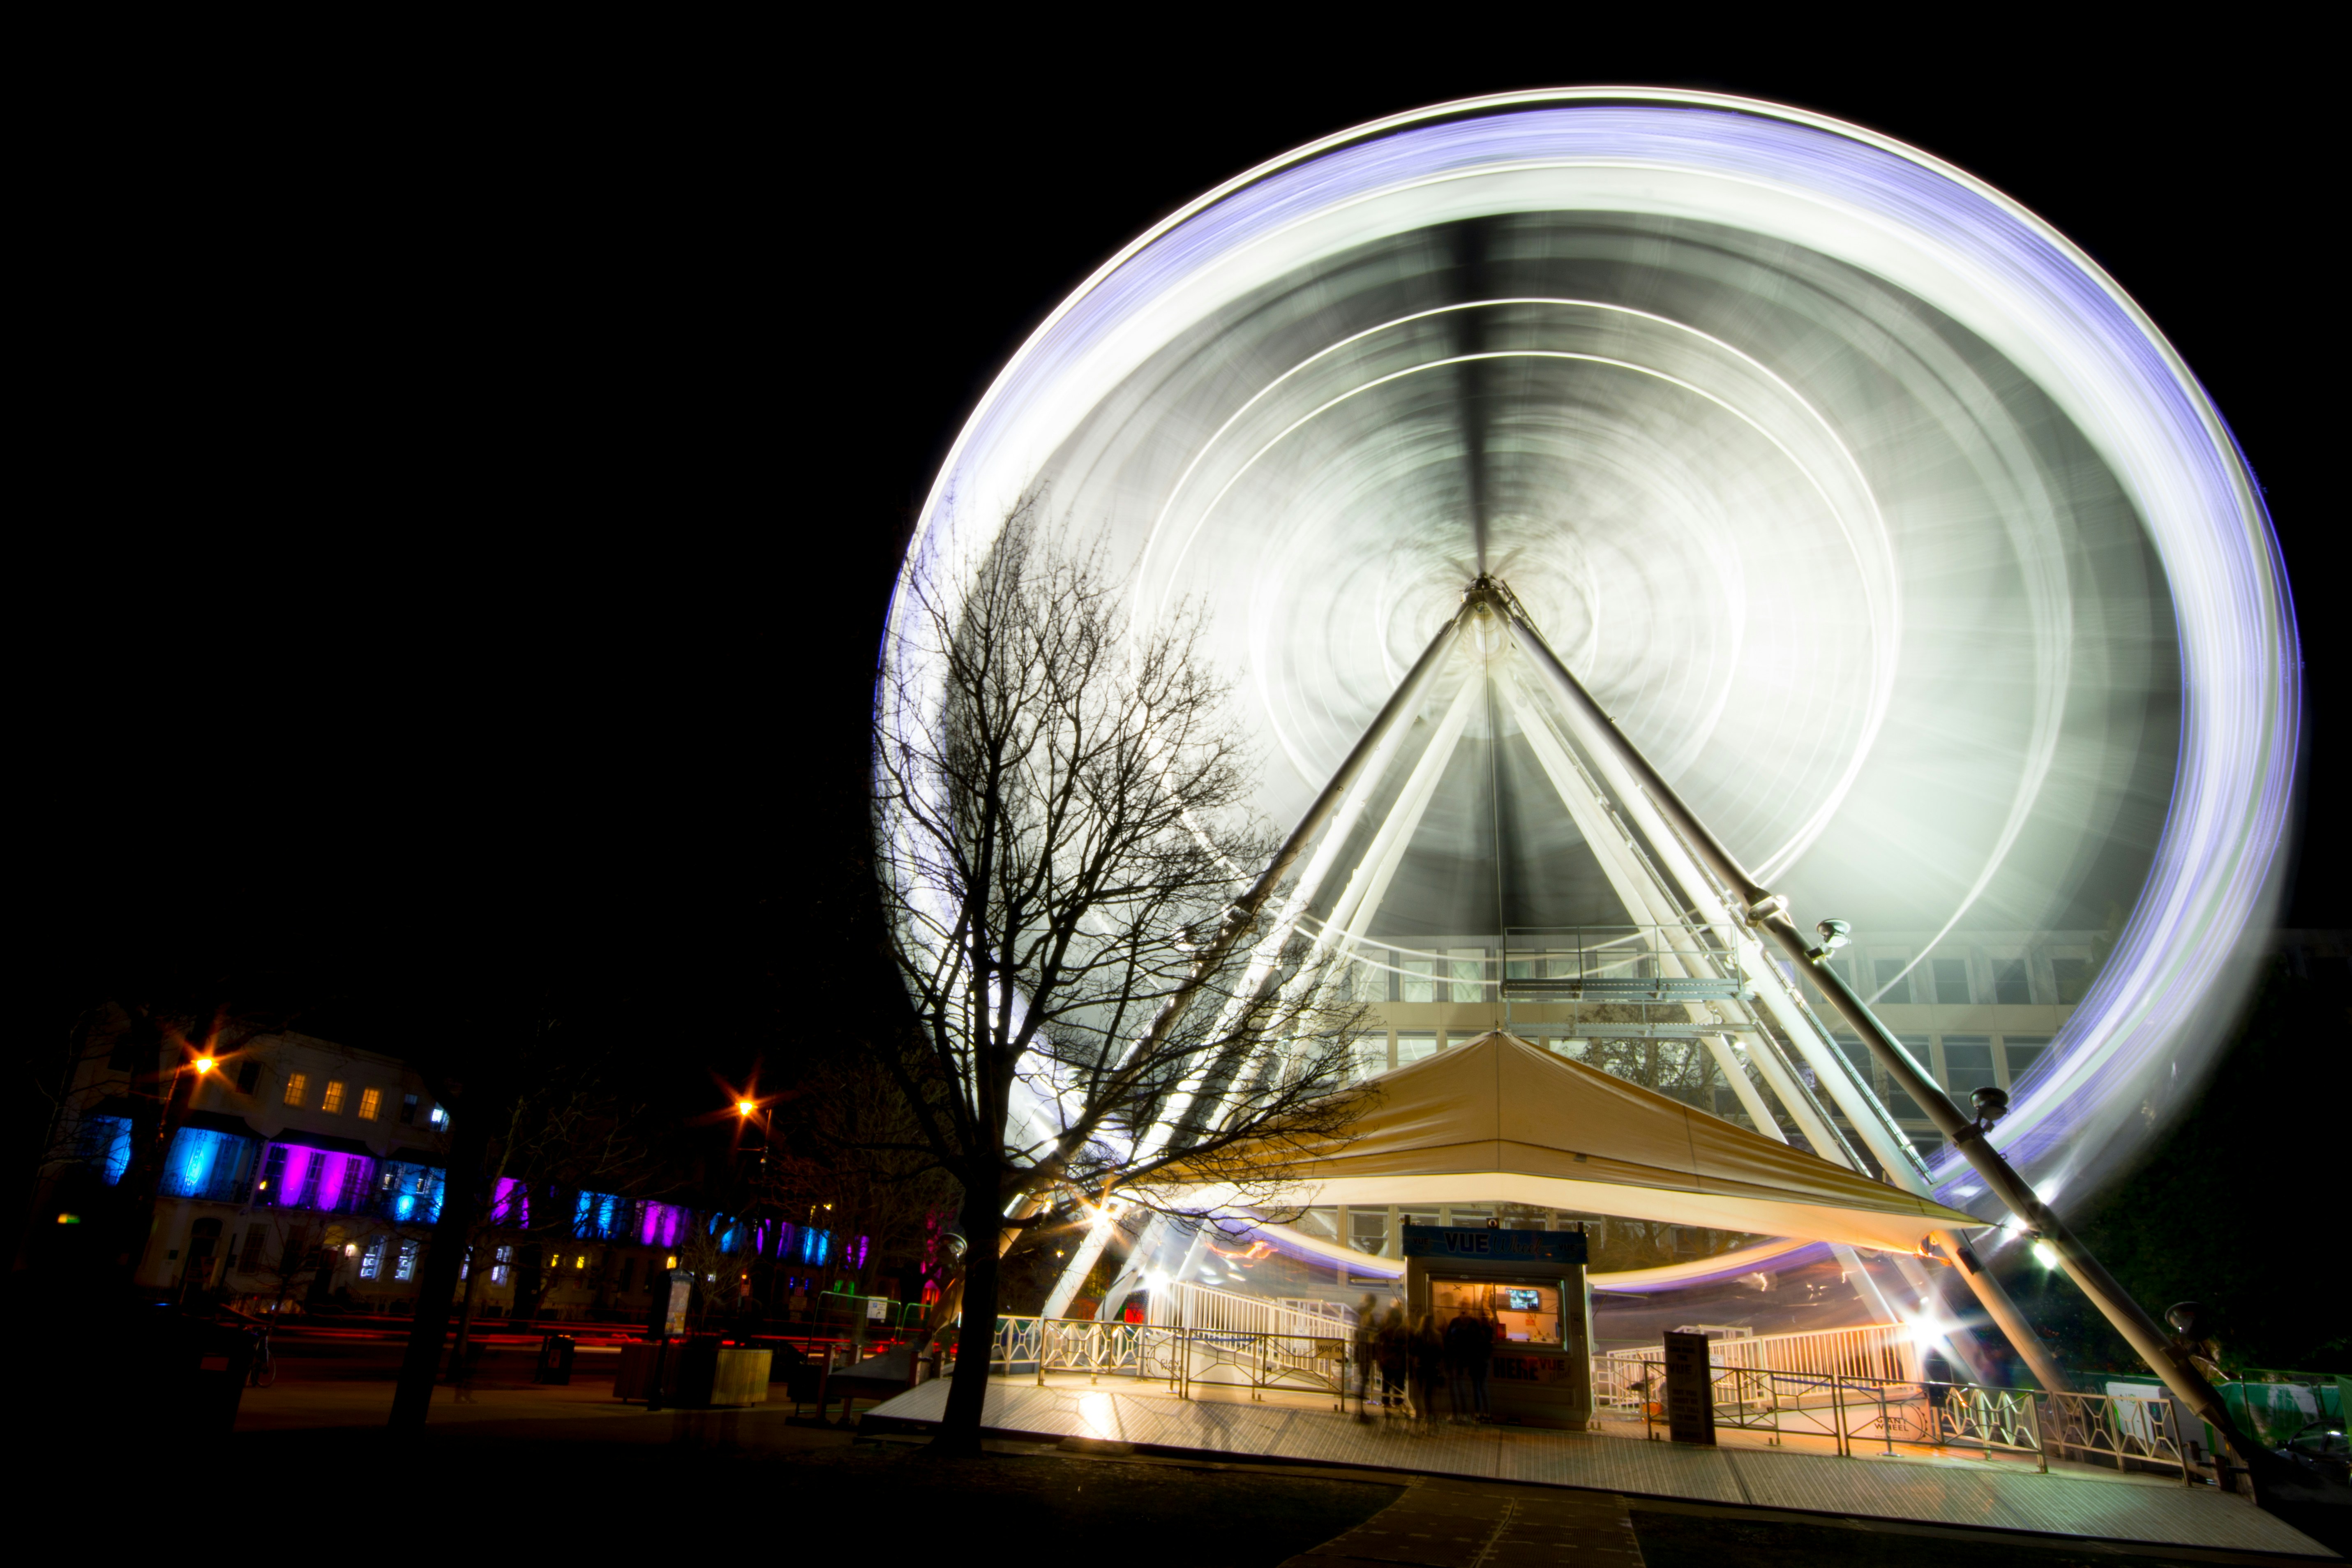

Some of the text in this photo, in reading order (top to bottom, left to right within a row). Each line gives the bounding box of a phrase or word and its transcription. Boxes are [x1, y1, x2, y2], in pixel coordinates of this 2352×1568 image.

[1444, 1232, 1543, 1255] VUE Wheel
[1558, 1243, 1575, 1252] VUE
[1493, 1357, 1565, 1381] HERE VUE
[1550, 1364, 1571, 1383] Wheel
[1668, 1363, 1692, 1374] VUE
